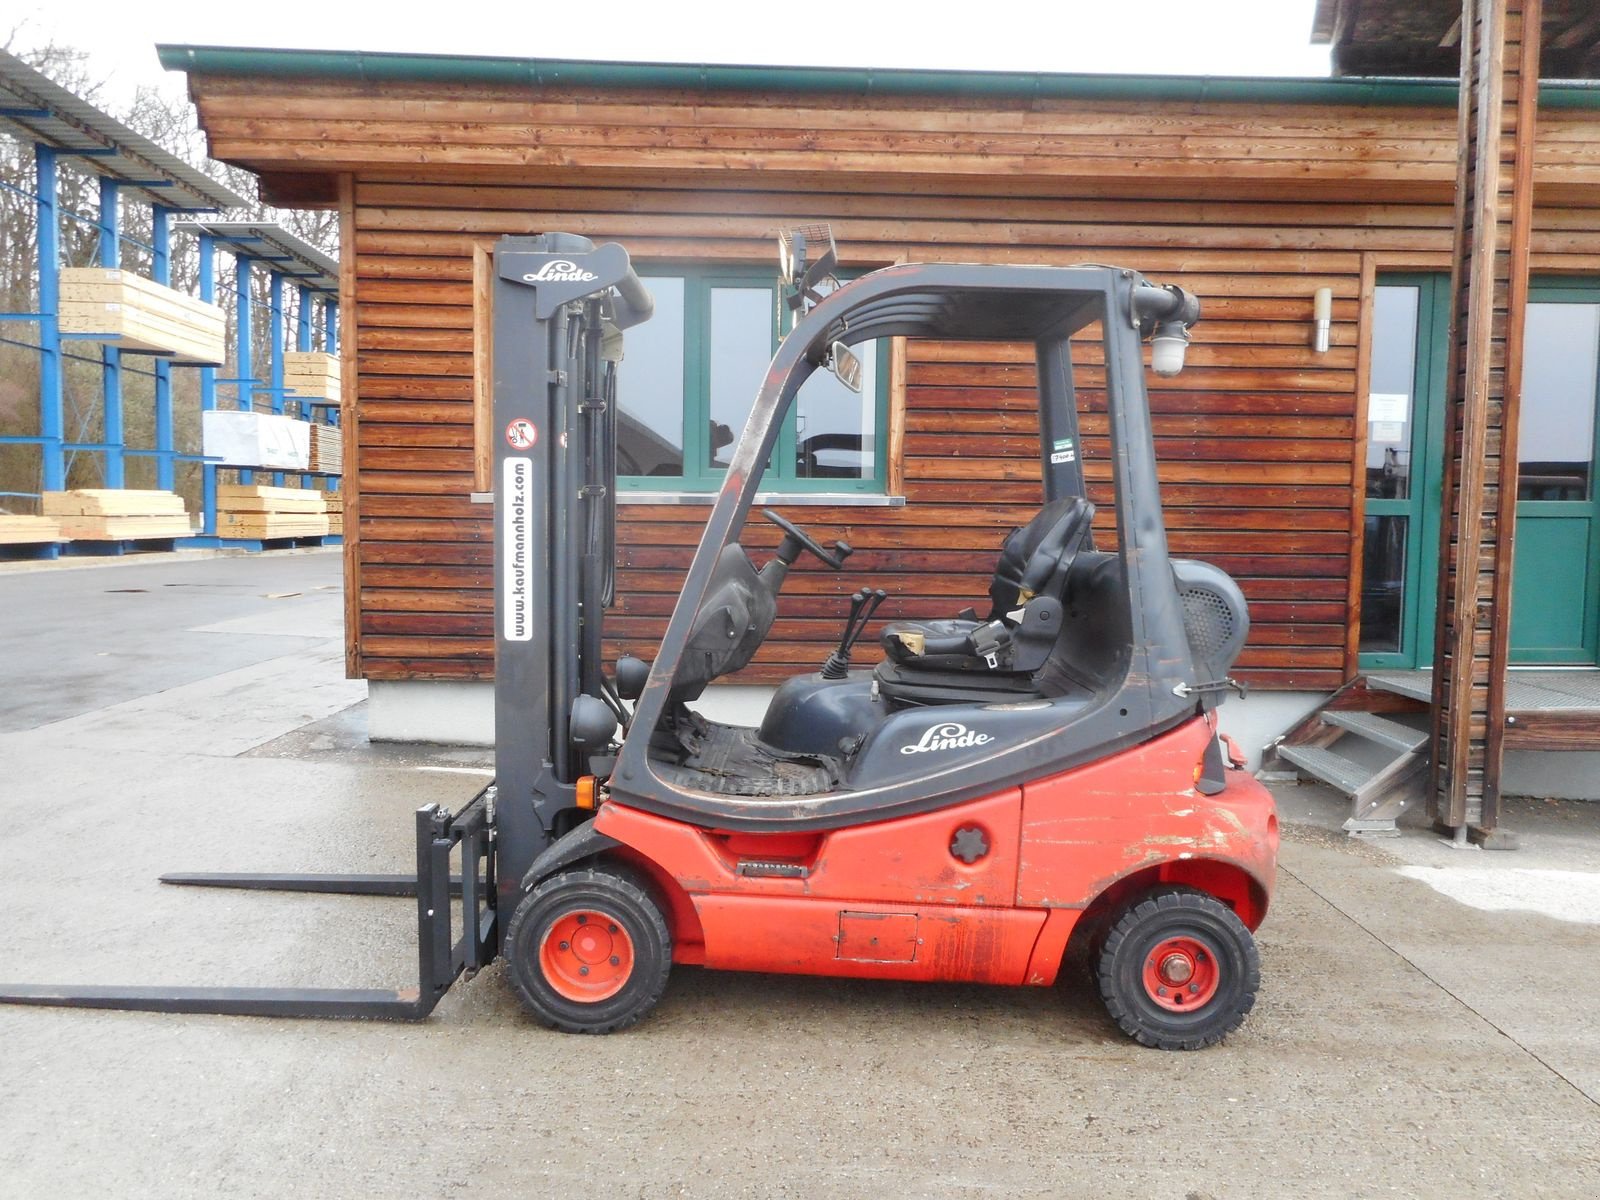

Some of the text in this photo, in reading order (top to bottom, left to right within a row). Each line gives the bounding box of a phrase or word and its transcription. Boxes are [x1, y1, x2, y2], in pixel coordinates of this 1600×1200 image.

[523, 260, 598, 281] Linde
[512, 463, 525, 637] www.kaufmannholz.com
[901, 723, 995, 754] Linde
